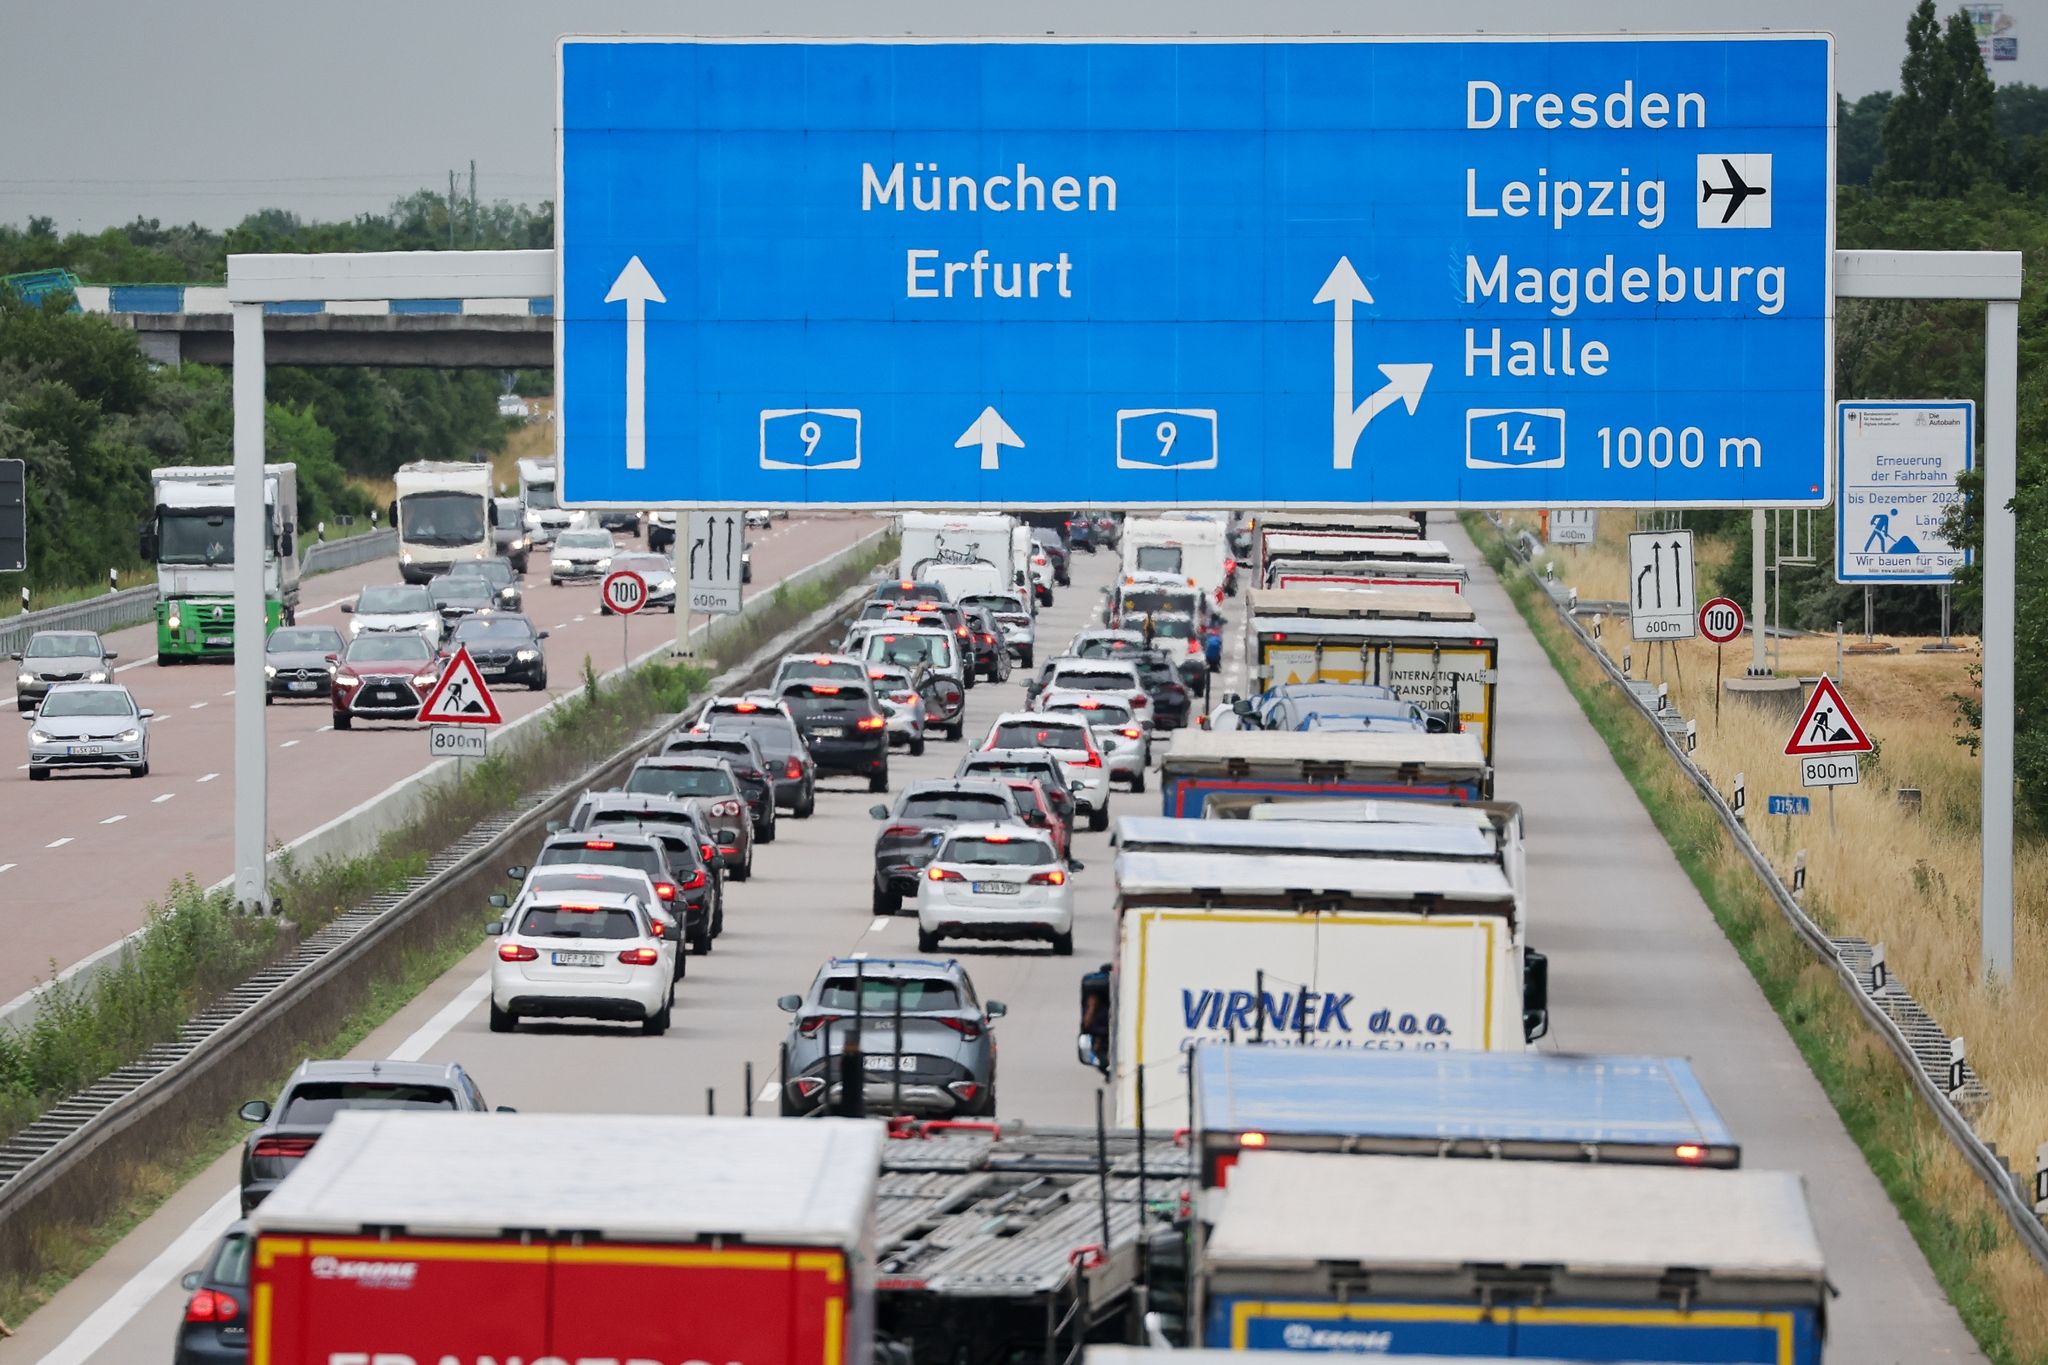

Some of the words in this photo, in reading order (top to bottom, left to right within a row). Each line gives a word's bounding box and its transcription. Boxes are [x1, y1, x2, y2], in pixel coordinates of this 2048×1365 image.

[1467, 80, 1706, 129] Dresden
[862, 162, 1117, 212] München
[1466, 167, 1666, 230] Leipzig
[906, 249, 1072, 298] Erfurt
[1466, 254, 1785, 317] Magdeburg
[1465, 327, 1610, 377] Halle
[1928, 412, 1940, 420] Die
[799, 421, 821, 457] 9
[1156, 421, 1177, 457] 9
[1497, 421, 1536, 456] 14
[1597, 426, 1705, 469] 1000
[1719, 437, 1762, 468] m
[1876, 455, 1942, 468] Erneuerung
[1871, 471, 1890, 482] der
[1894, 471, 1948, 481] Fahrbahn
[1848, 493, 1865, 504] bis
[1869, 493, 1928, 504] Dezember
[1932, 492, 1960, 504] 2023
[1915, 515, 1946, 527] Läng
[1855, 556, 1875, 566] Wir
[1878, 556, 1911, 566] bauen
[1916, 555, 1933, 566] für
[1936, 556, 1954, 566] Sie
[613, 582, 638, 602] 100
[693, 594, 727, 607] 600m
[1645, 620, 1681, 633] 600m
[1707, 610, 1735, 632] 100
[434, 733, 482, 748] 800m
[1806, 763, 1854, 780] 800m
[1181, 988, 1354, 1033] VIRNEK
[1368, 1008, 1452, 1035] d.o.o.
